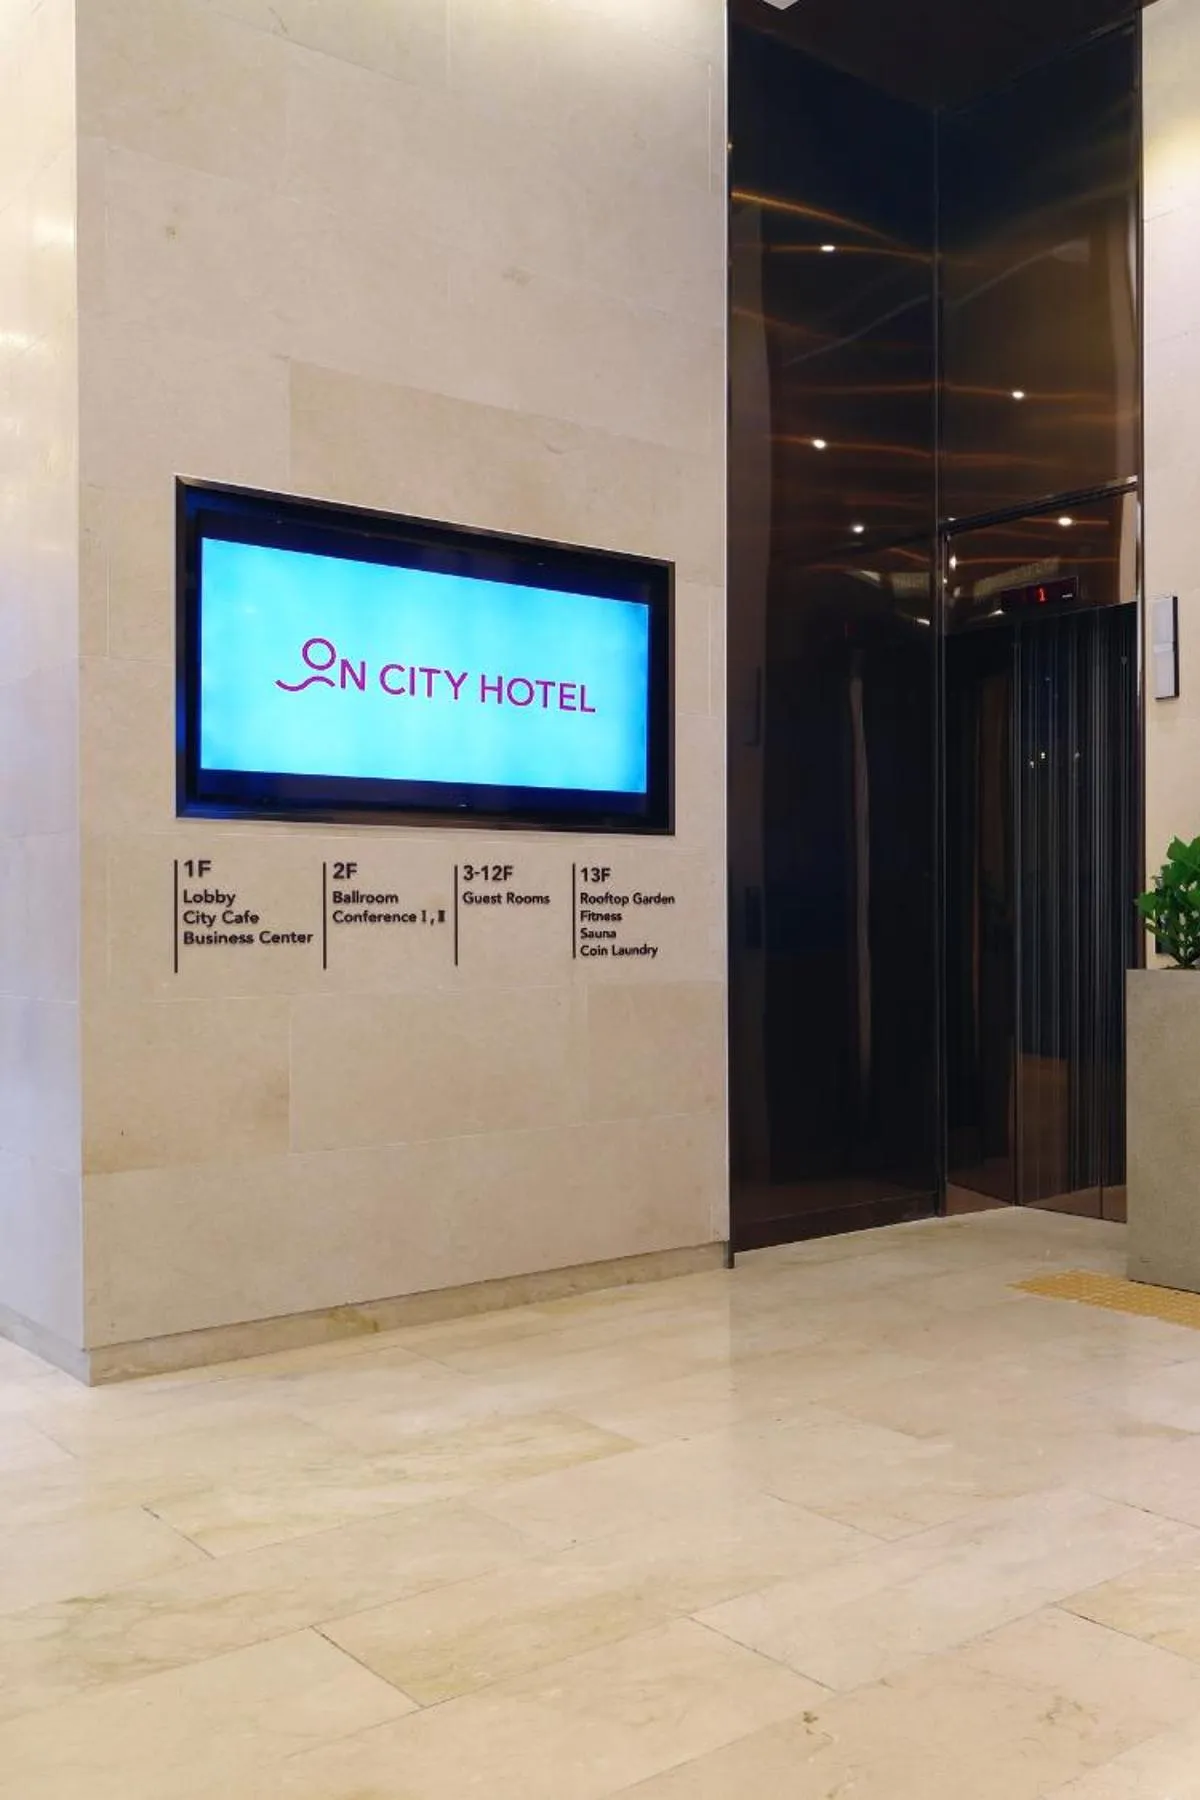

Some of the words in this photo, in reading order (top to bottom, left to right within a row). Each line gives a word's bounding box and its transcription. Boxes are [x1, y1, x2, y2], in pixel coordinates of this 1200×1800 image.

[302, 637, 367, 691] ON
[379, 663, 468, 700] CITY
[480, 674, 596, 713] HOTEL
[183, 860, 211, 878] 1F
[332, 862, 358, 879] 2F
[463, 865, 514, 881] 3-12F
[580, 867, 611, 883] 13F
[183, 889, 236, 907] Lobby
[332, 891, 399, 904] Ballroom
[462, 892, 501, 905] Guest
[506, 892, 551, 905] Rooms
[580, 892, 629, 907] Rooftop
[633, 892, 675, 905] Garden
[183, 910, 216, 927] City
[222, 910, 260, 924] Cafe
[332, 910, 417, 923] Conference
[580, 910, 622, 922] Fitness
[183, 931, 254, 945] Business
[259, 931, 314, 944] Center
[580, 928, 617, 939] Sauna
[580, 945, 609, 957] Coin
[612, 944, 658, 958] Laundry
